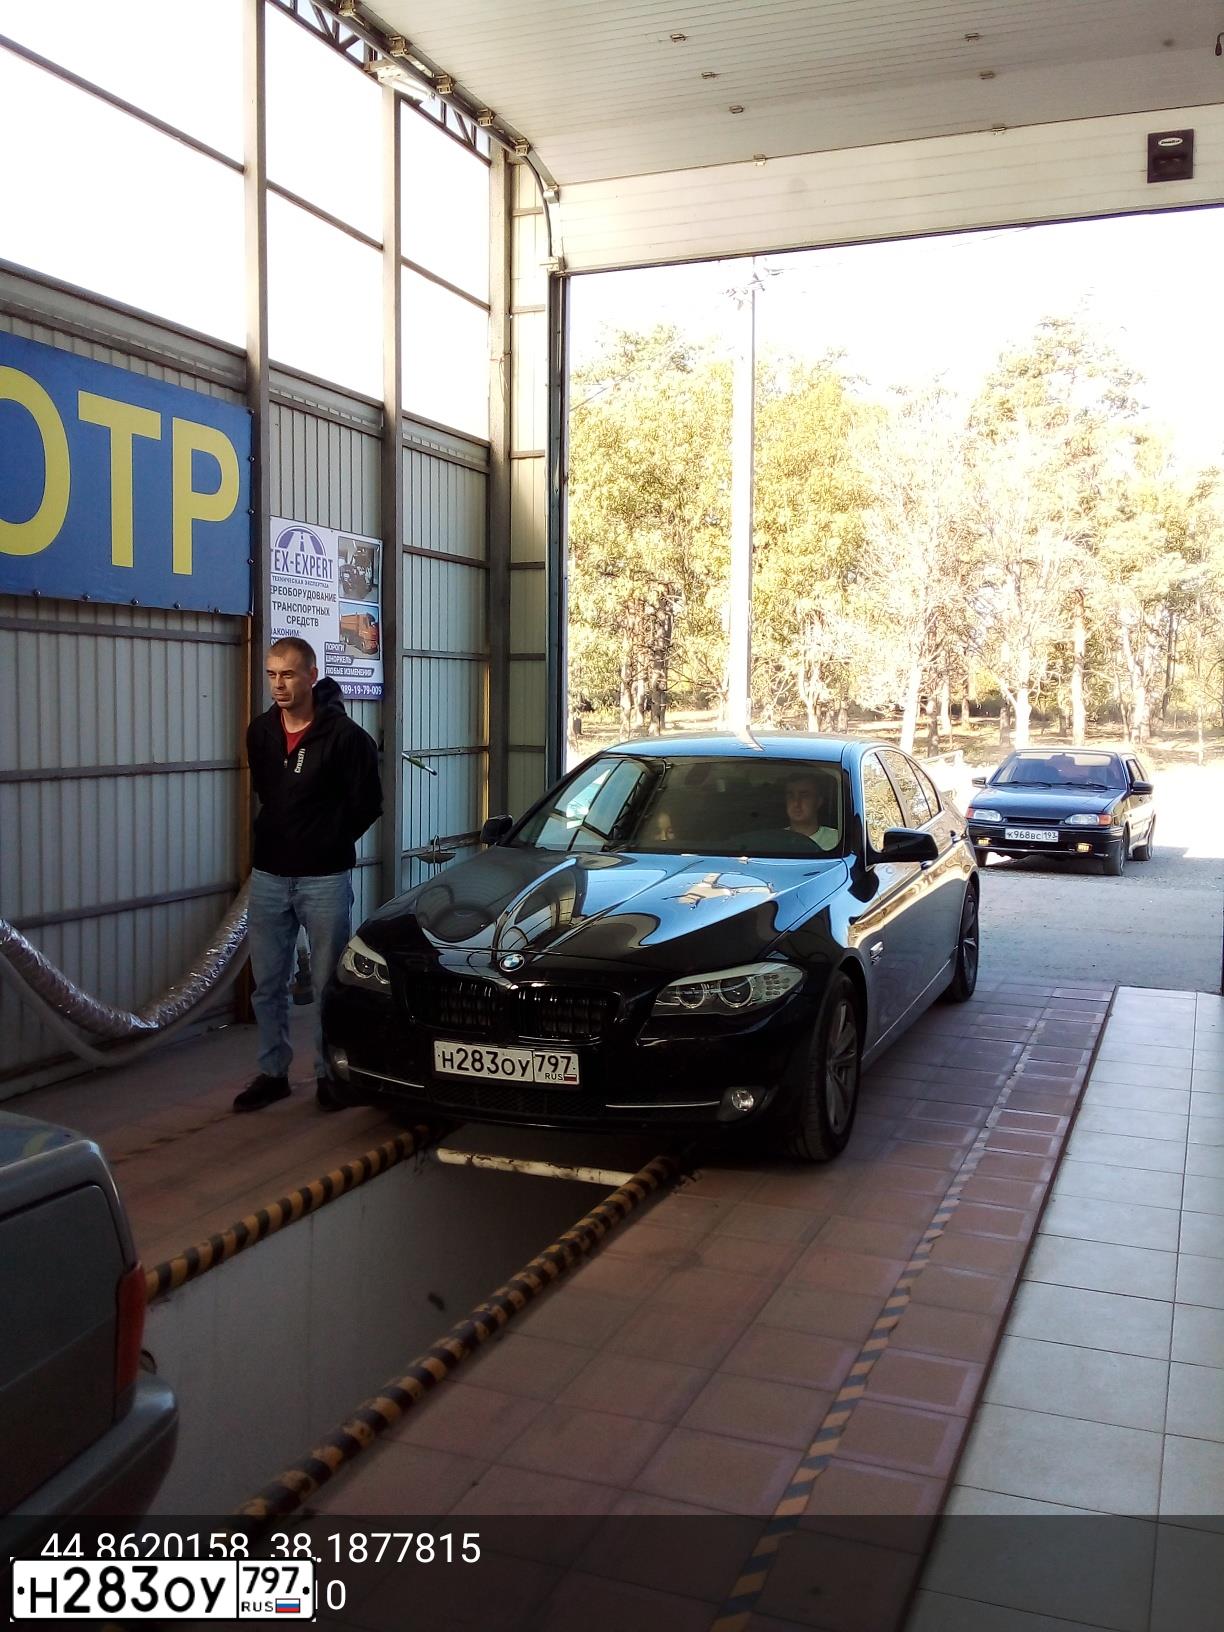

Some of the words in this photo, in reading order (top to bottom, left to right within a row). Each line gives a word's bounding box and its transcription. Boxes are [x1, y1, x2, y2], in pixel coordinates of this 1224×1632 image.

[271, 549, 333, 580] EX-EXPERT
[272, 600, 330, 616] ТРАНСПОРТНЫХ
[286, 615, 319, 628] СРЕДСТВ
[534, 1053, 572, 1074] 797
[545, 1072, 563, 1081] RUS
